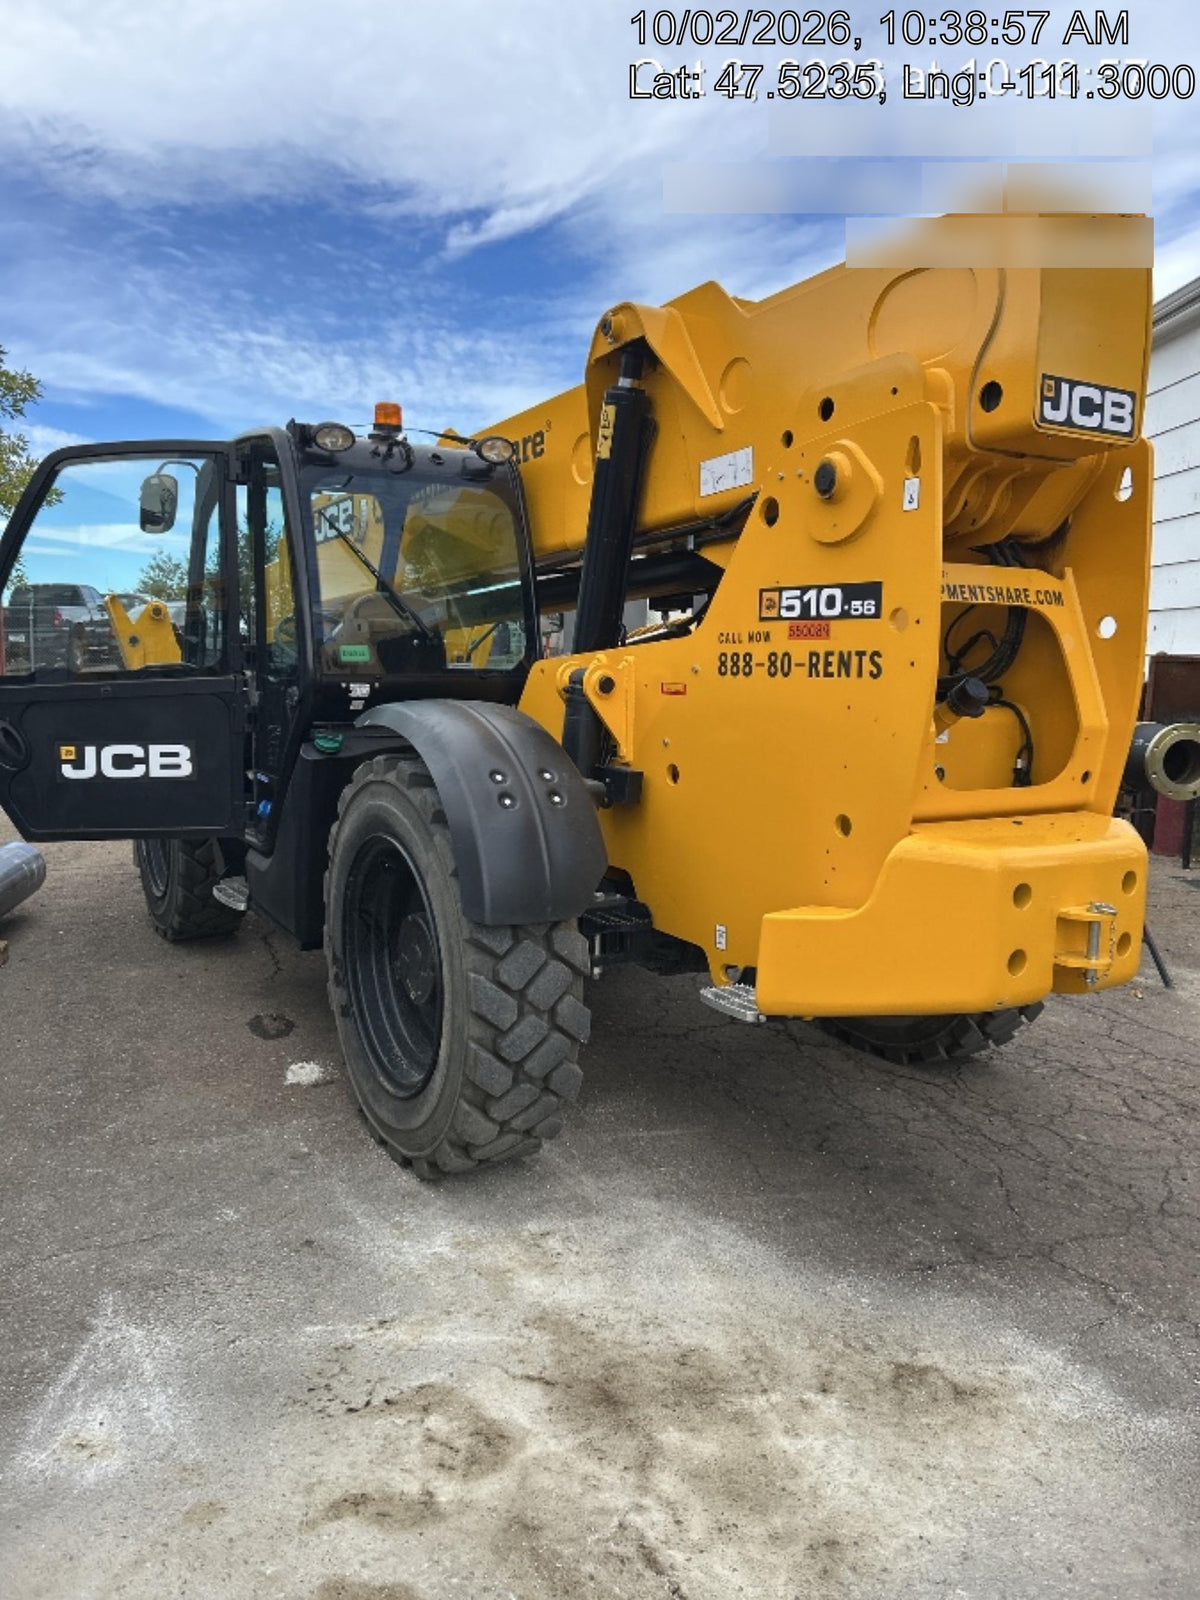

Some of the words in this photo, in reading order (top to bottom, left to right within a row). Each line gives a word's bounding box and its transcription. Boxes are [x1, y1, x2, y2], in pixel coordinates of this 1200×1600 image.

[1043, 381, 1134, 433] JCB
[717, 632, 743, 645] CALL
[748, 630, 772, 644] NOW
[717, 650, 883, 680] 888-80-RENTS
[60, 743, 193, 780] JCB
